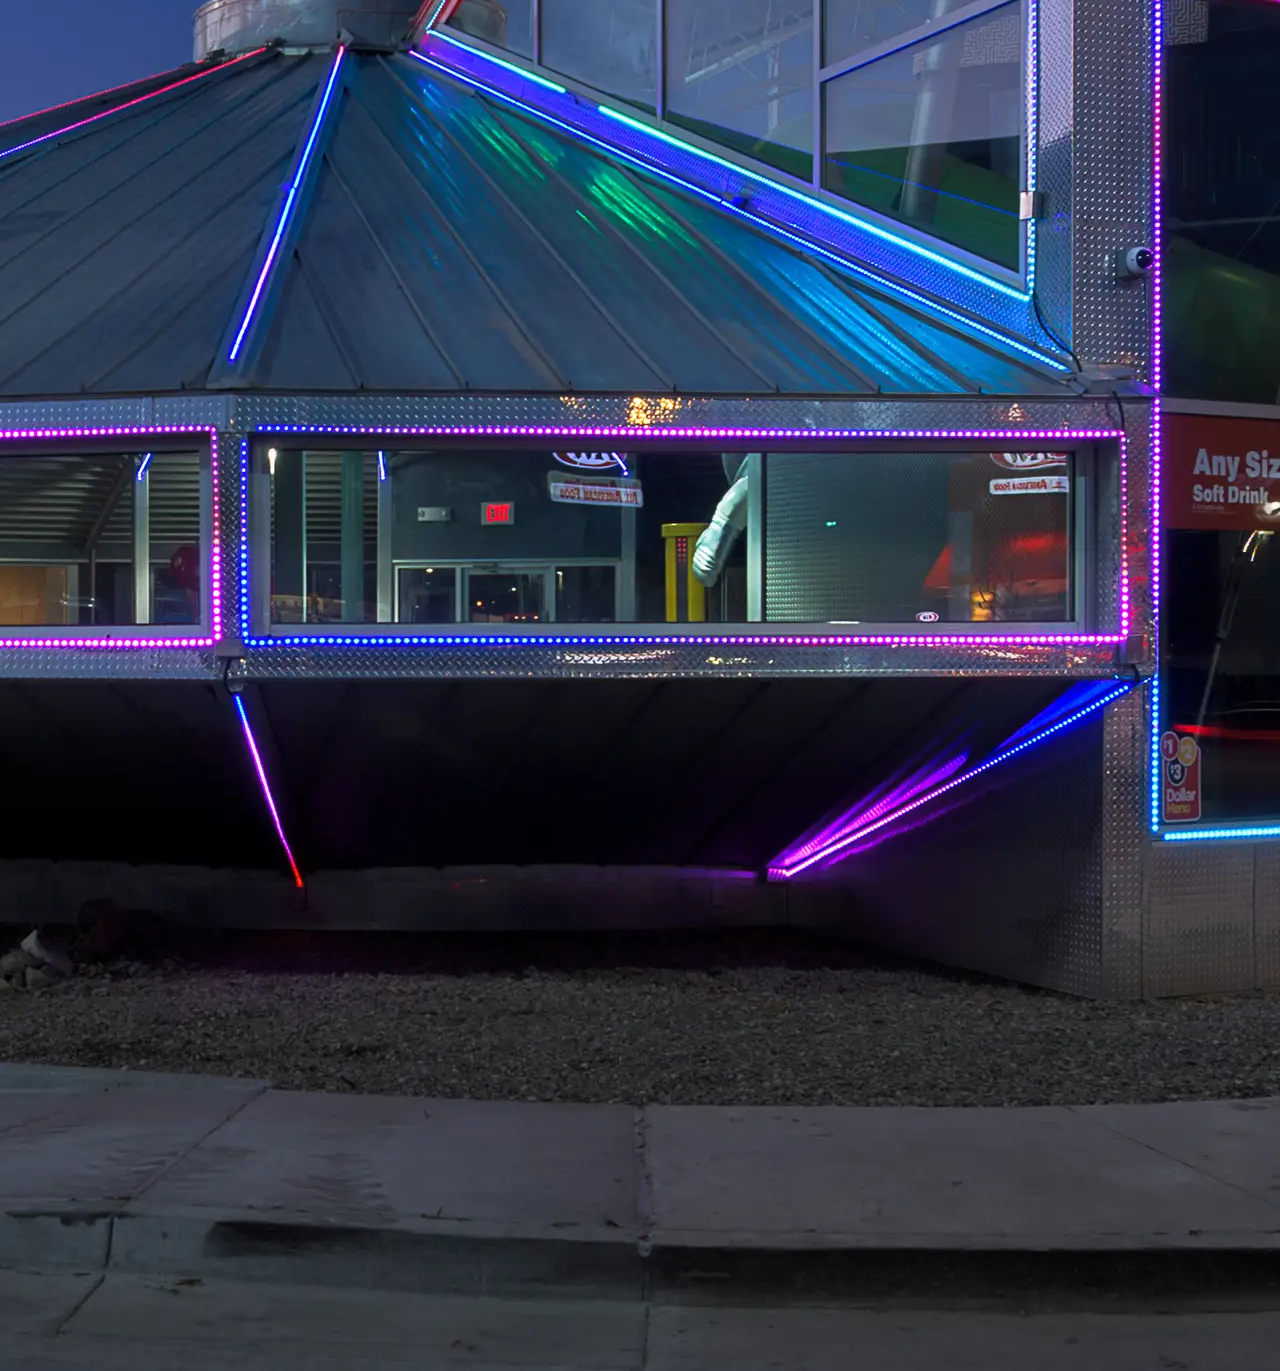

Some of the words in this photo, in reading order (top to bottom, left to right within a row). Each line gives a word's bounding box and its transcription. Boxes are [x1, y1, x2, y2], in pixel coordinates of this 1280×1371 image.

[1193, 448, 1240, 482] Any
[1193, 484, 1225, 502] Soft
[1228, 486, 1270, 505] Drink
[487, 504, 510, 522] EXIT
[1167, 787, 1196, 802] Dollar
[1167, 803, 1191, 814] Menu
